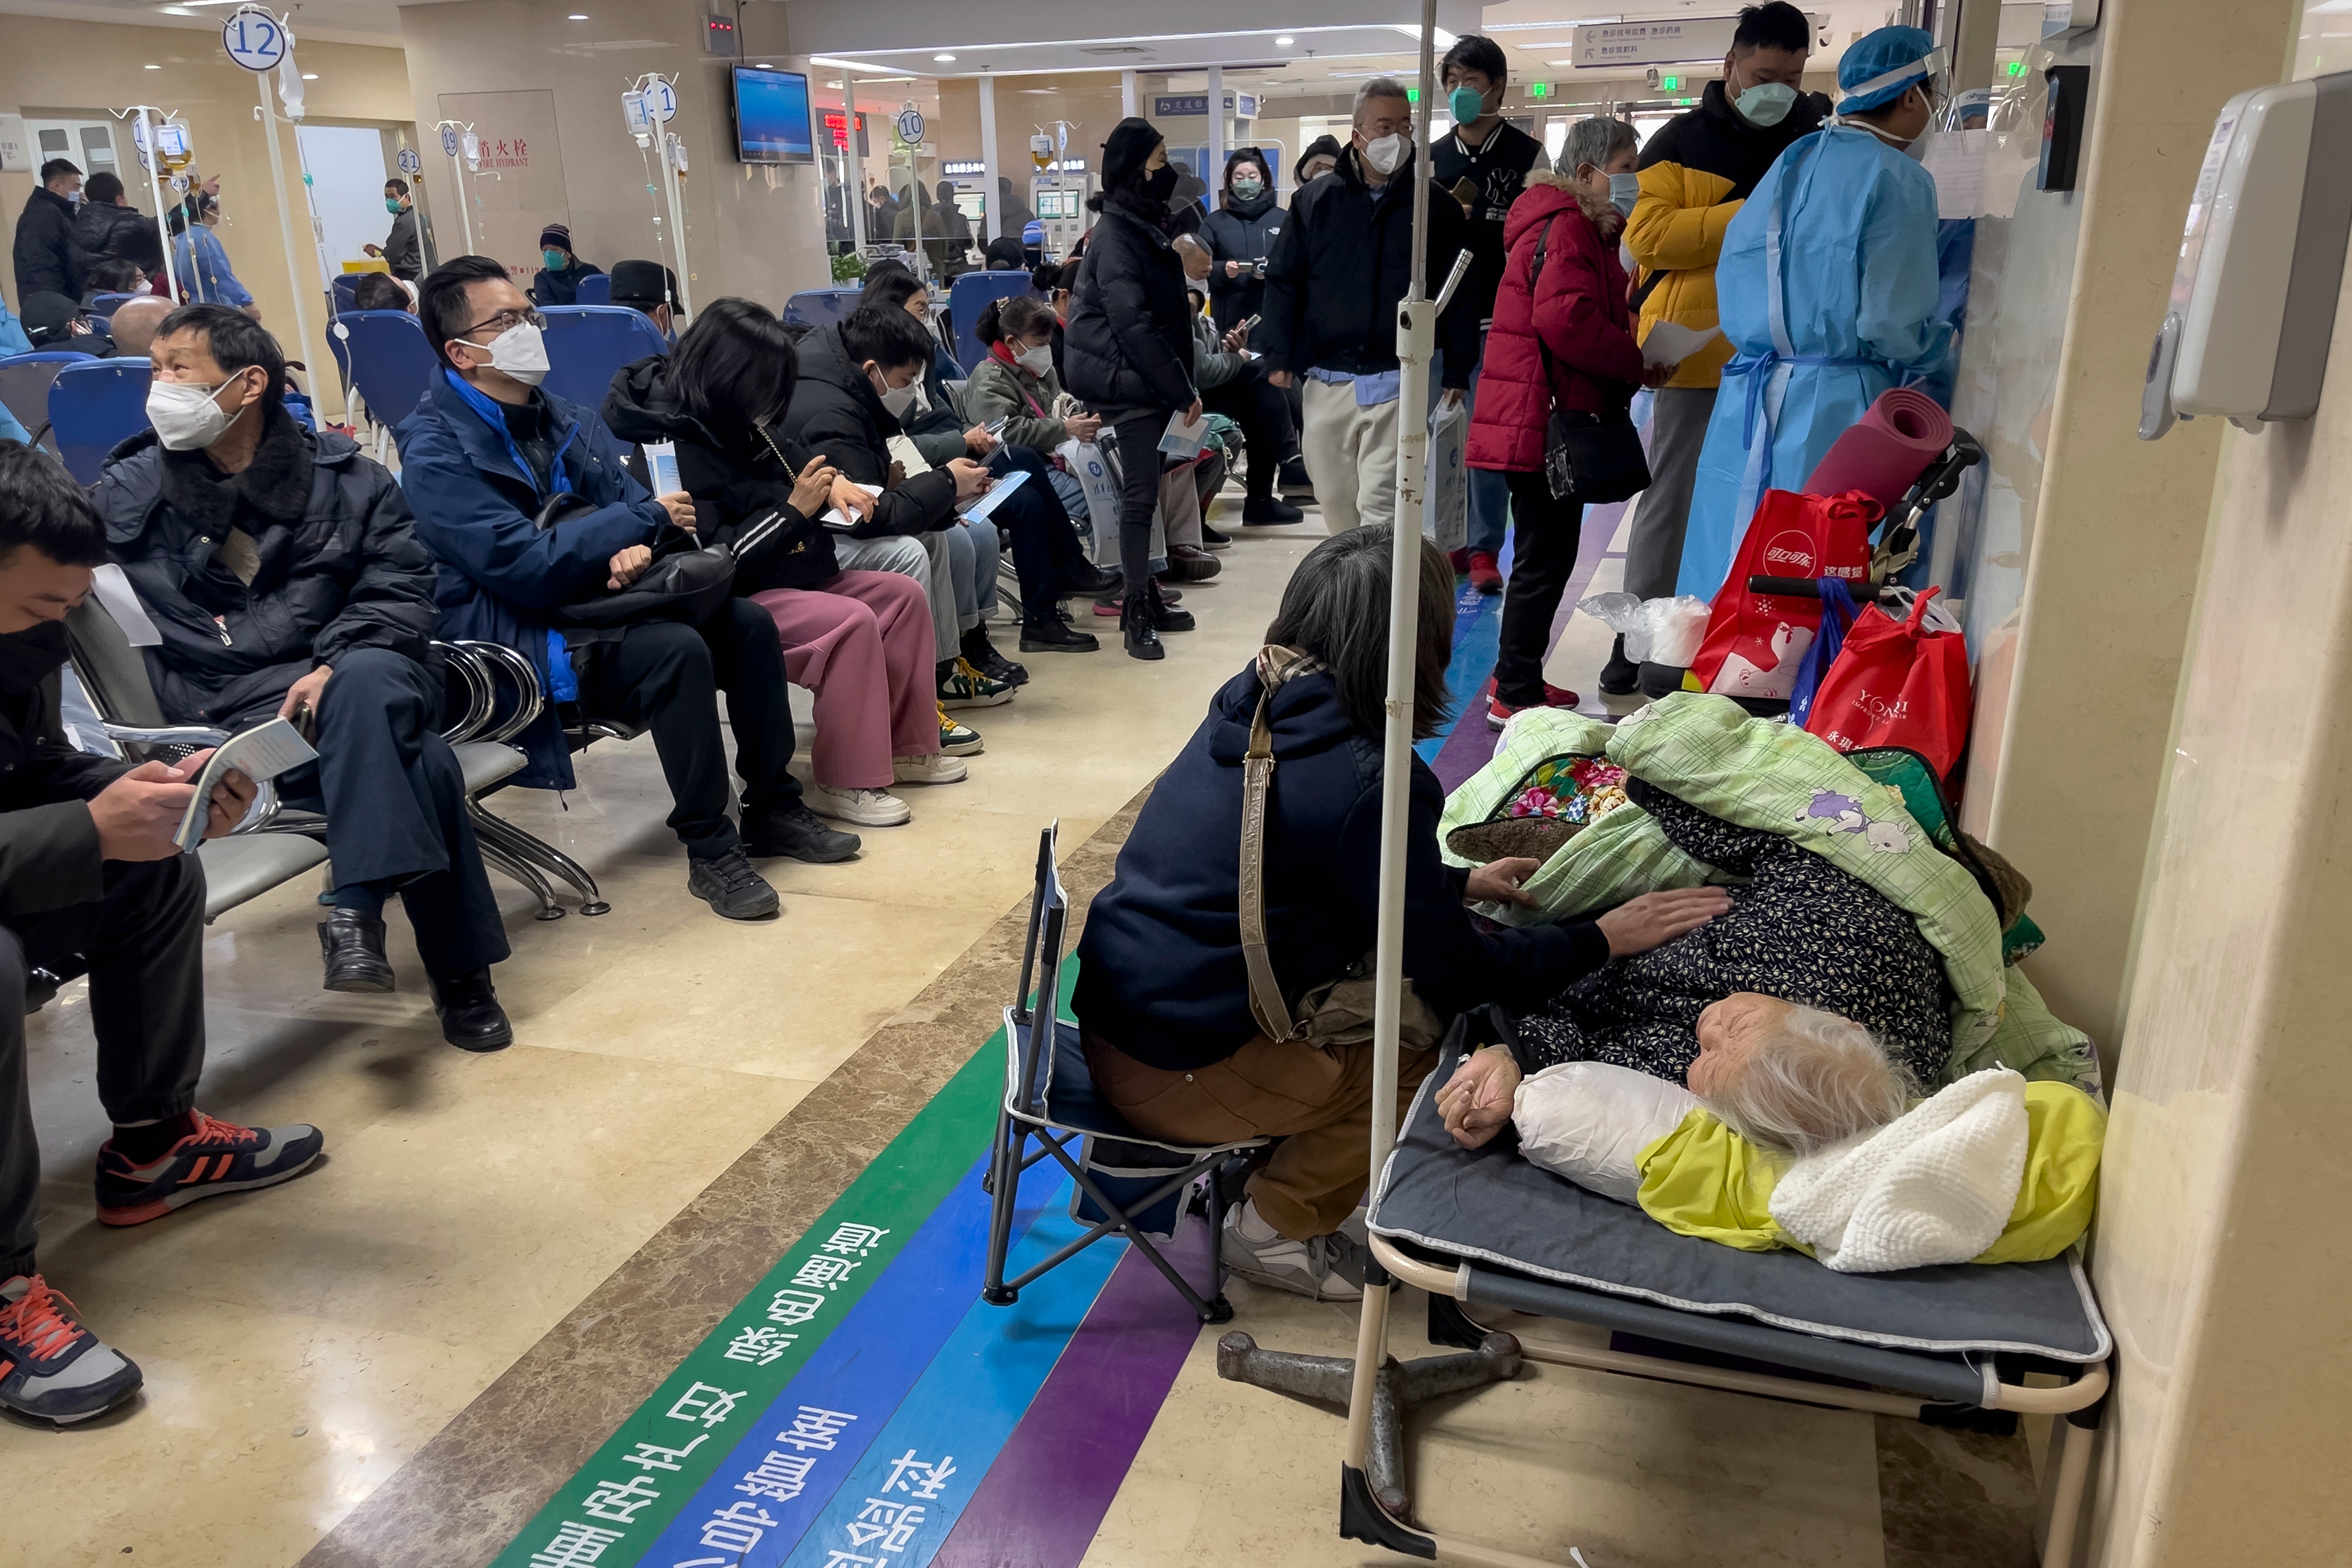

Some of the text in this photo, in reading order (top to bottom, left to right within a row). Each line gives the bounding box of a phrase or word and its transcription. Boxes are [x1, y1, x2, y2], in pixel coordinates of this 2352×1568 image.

[234, 21, 278, 56] 12
[1175, 99, 1209, 109] 交通银
[901, 115, 922, 136] 10
[443, 132, 456, 149] 19
[479, 138, 528, 157] 消火栓
[401, 153, 418, 169] 21
[496, 158, 528, 167] HYDRANT
[1485, 168, 1517, 205] NY
[1767, 547, 1814, 568] 可口可乐
[1824, 566, 1863, 578] 这感觉
[723, 1221, 890, 1366] 绿色通道
